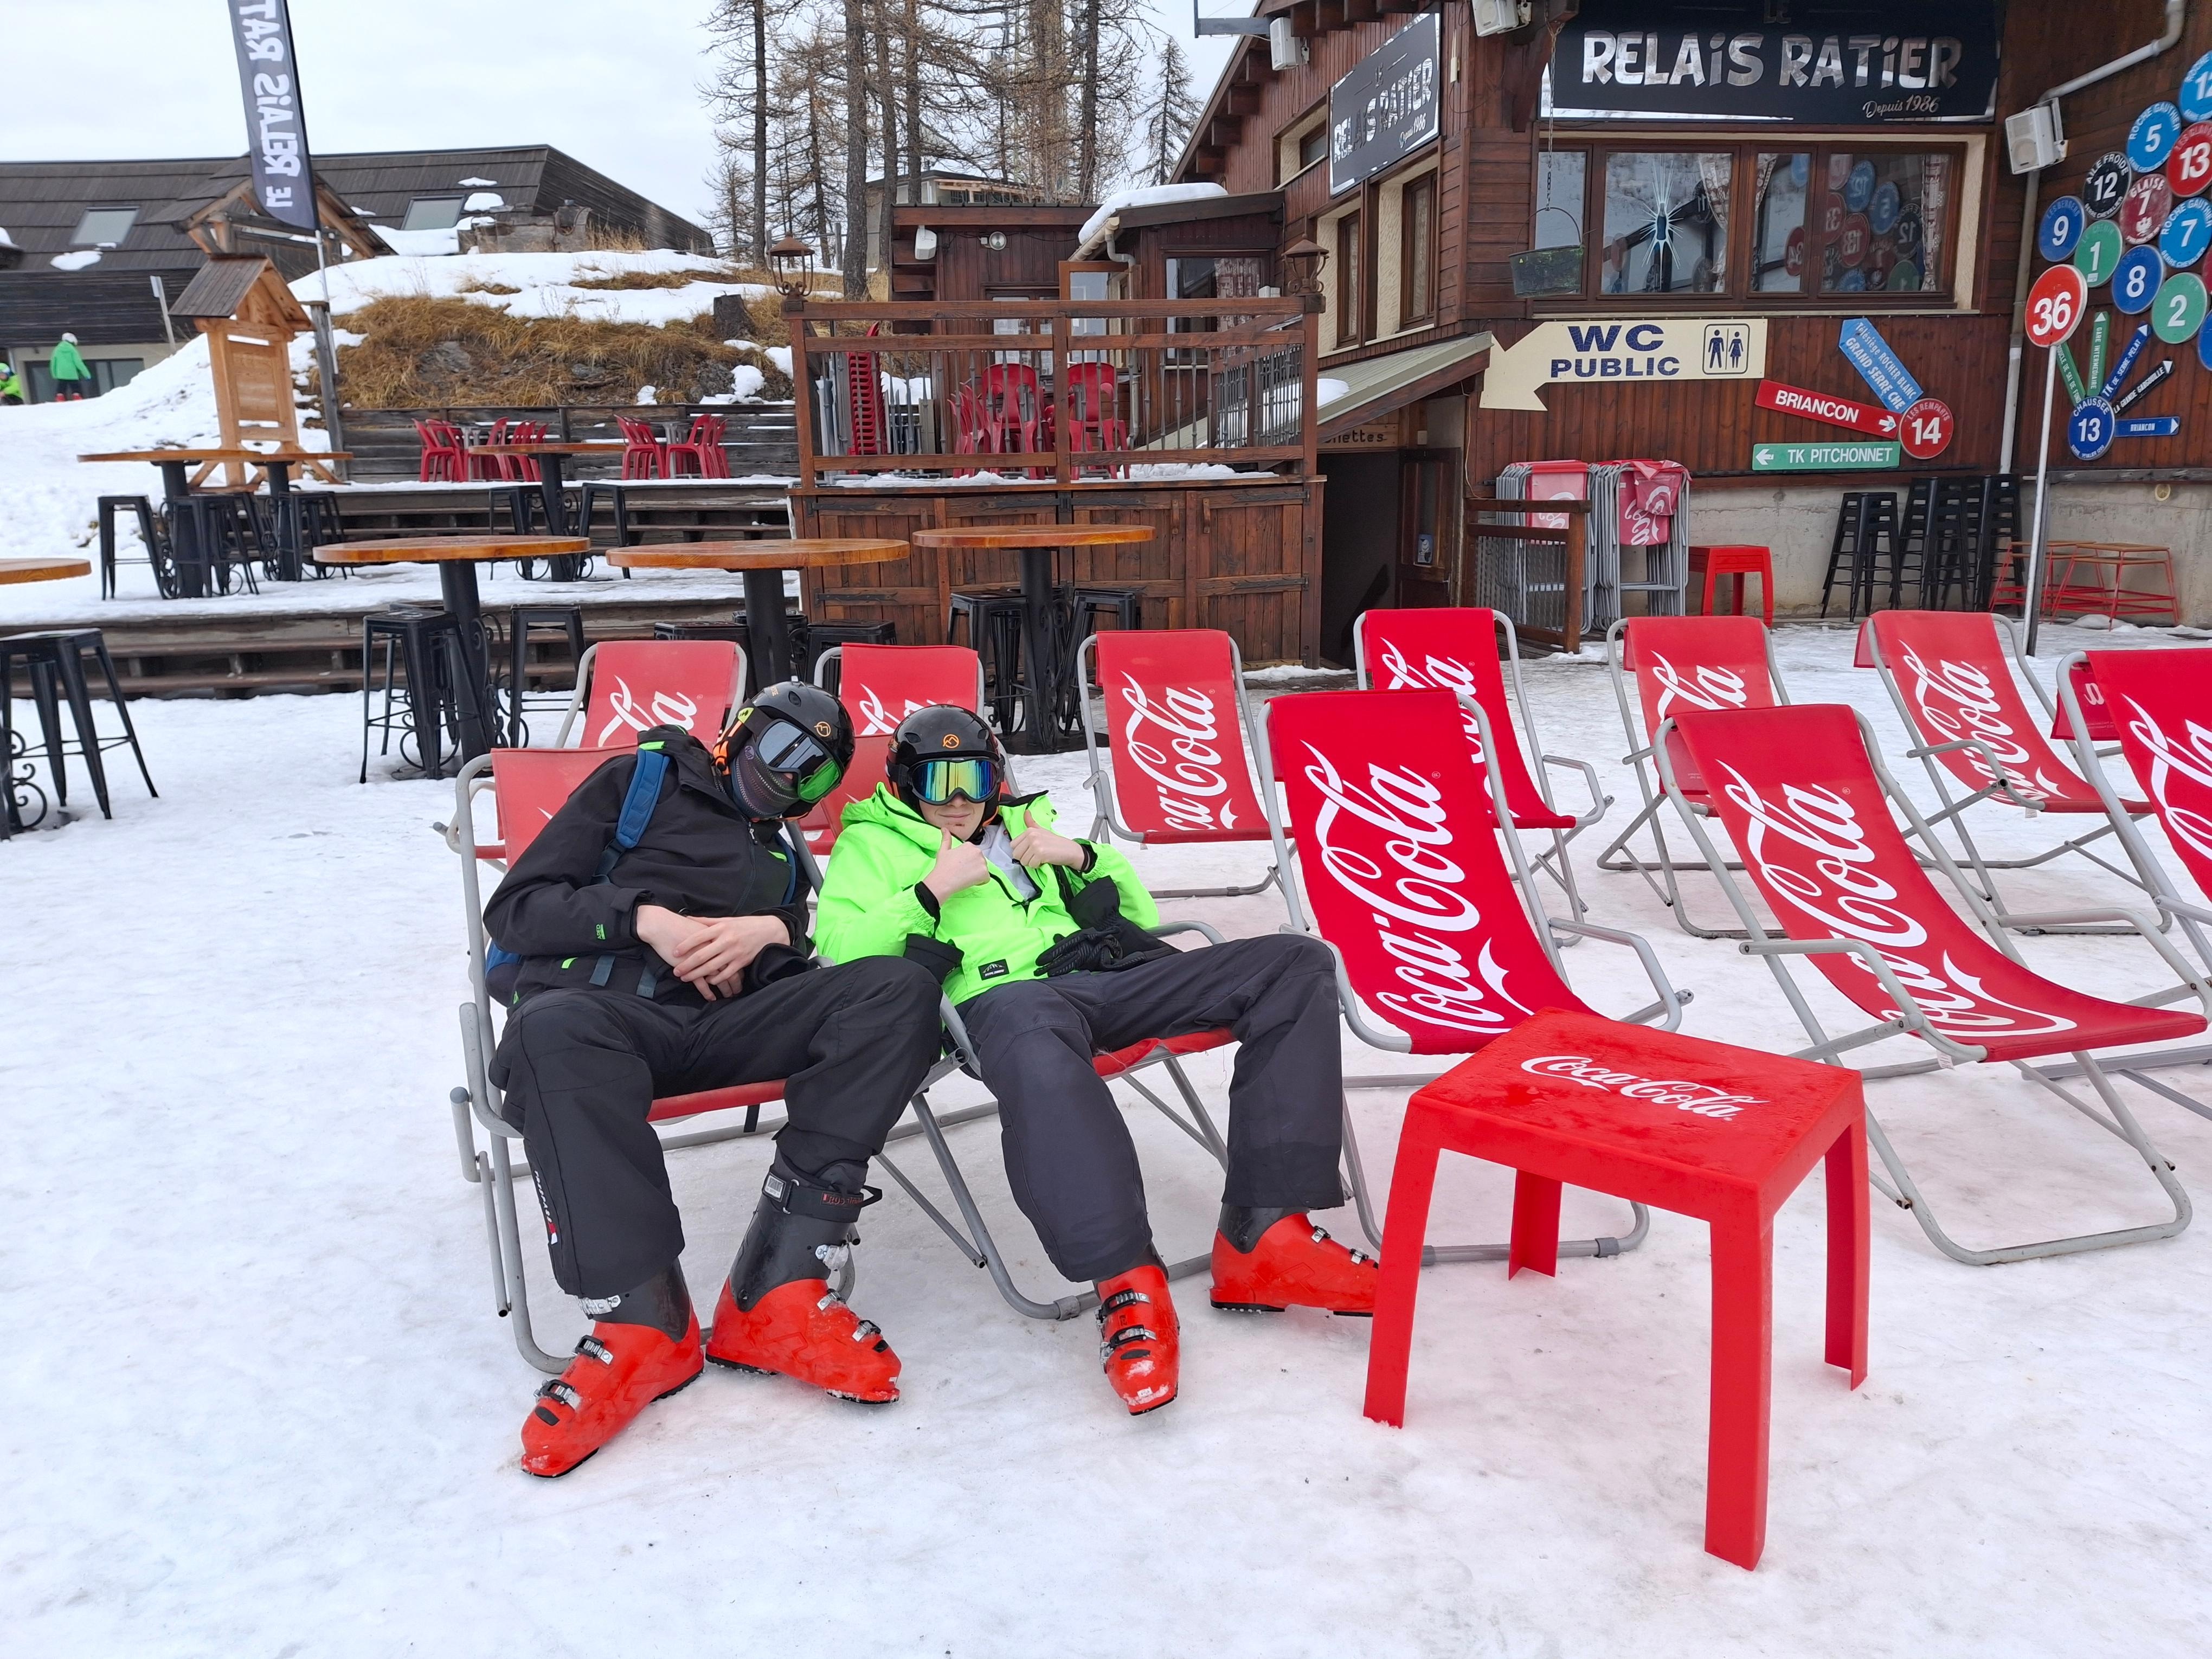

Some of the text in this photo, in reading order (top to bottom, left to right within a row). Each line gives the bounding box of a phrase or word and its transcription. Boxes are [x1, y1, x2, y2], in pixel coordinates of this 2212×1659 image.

[1863, 95, 1940, 118] Depuis 1986
[1413, 112, 1426, 133] 1986
[2145, 123, 2162, 152] 5
[2086, 153, 2130, 184] AILE FROIDE
[2179, 142, 2211, 181] 13
[2094, 171, 2118, 202] 12
[2130, 177, 2165, 198] GLAISE
[2138, 189, 2152, 216] 7
[2053, 216, 2069, 246] 9
[2161, 202, 2187, 235] ROCHE
[2181, 218, 2198, 248] 7
[2090, 241, 2101, 271] 1
[2126, 265, 2146, 298] 8
[2033, 291, 2072, 336] 36
[2168, 294, 2188, 327] 2
[1568, 324, 1664, 352] WC
[1551, 356, 1680, 378] PUBLIC
[1846, 337, 1873, 368] GRAND
[1868, 366, 1894, 394] SERRE
[1878, 352, 1901, 380] ROCHER
[1896, 376, 1917, 400] BLANC
[2091, 345, 2101, 389] INTERMEDIAIRE
[2062, 364, 2070, 372] DE
[2069, 382, 2076, 390] DE
[2073, 389, 2082, 404] FOND
[2102, 383, 2115, 397] TK
[2112, 376, 2119, 385] DE
[1776, 390, 1860, 423] BRIANCON
[1907, 402, 1951, 421] LES REMPARTS
[2073, 398, 2110, 417] CHAUSSEE
[2114, 404, 2121, 414] LA
[2120, 389, 2138, 408] GRANDE
[1912, 417, 1941, 445] 14
[2078, 417, 2101, 442] 13
[2130, 423, 2156, 432] BRIANCON
[1787, 447, 1893, 464] TK PITCHONNET
